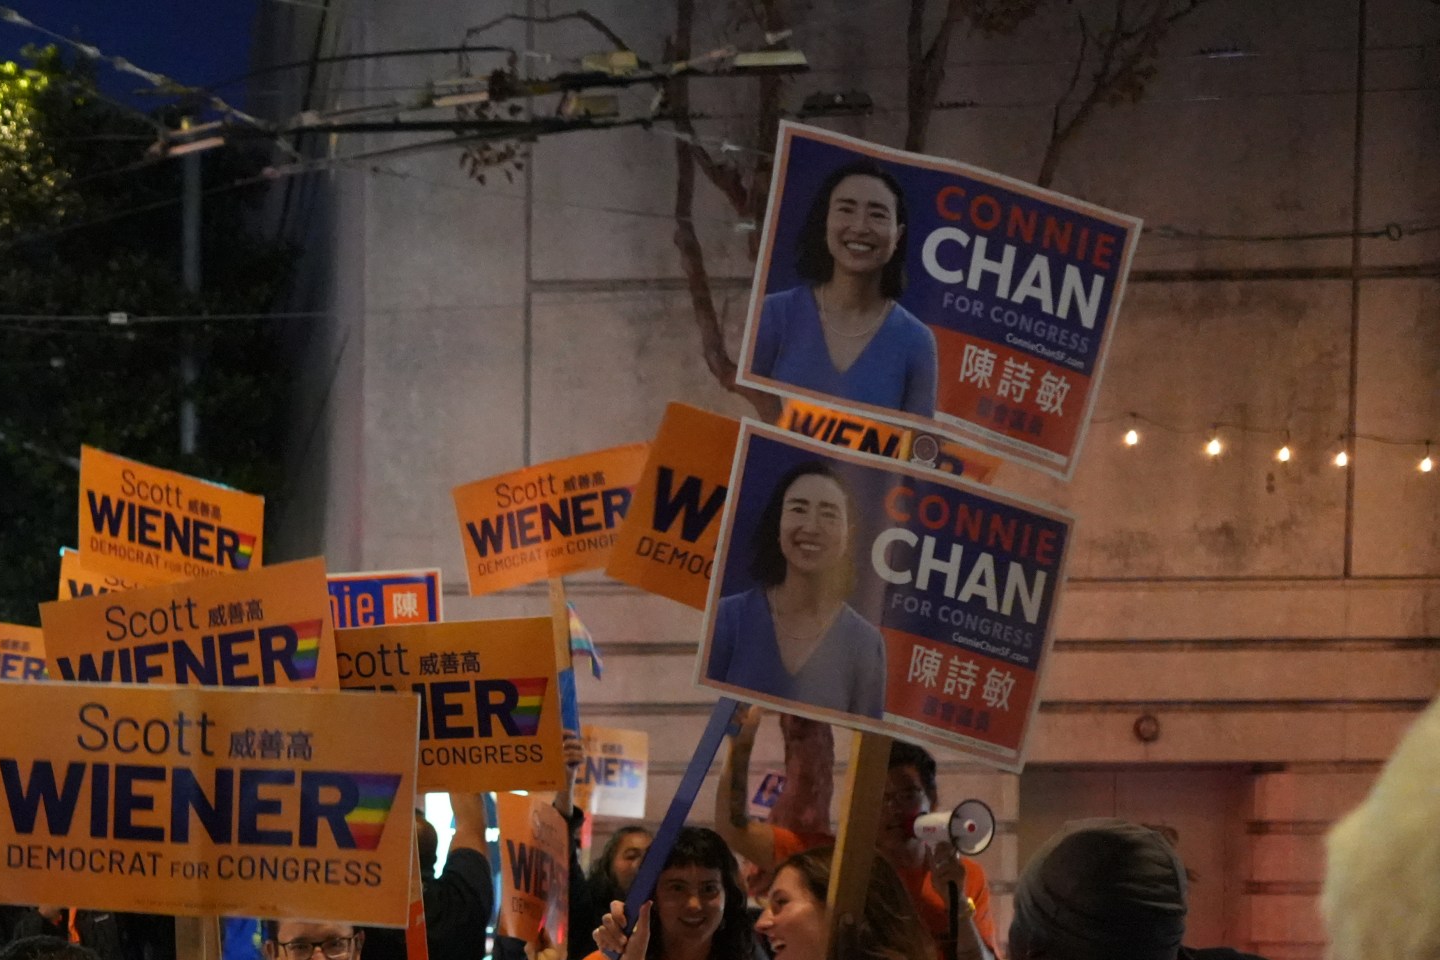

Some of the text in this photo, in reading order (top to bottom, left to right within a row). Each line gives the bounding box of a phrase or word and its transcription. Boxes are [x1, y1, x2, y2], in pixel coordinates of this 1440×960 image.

[936, 186, 1116, 270] CONNIE
[922, 226, 1105, 330] CHAN
[943, 292, 1091, 354] FOR CONGRESS
[959, 344, 1071, 416] 陳詩敏
[120, 468, 183, 510] Scott
[495, 472, 557, 509] Scott
[87, 489, 242, 570] WIENER
[466, 486, 633, 558] WIENER
[884, 486, 1057, 566] CONNIE
[90, 537, 160, 570] DEMOCRAT
[478, 548, 542, 576] DEMOCRAT
[635, 536, 713, 580] DEMOC
[871, 528, 1048, 625] CHAN
[105, 598, 200, 641] Scott
[208, 600, 264, 628] 威善高
[891, 593, 1034, 649] FOR CONGRESS
[57, 624, 300, 686] WIENER
[336, 642, 410, 680] cott
[419, 651, 481, 675] 威善高
[908, 644, 1016, 712] 陳詩敏
[76, 702, 216, 757] Scott
[228, 729, 314, 761] 威善高
[421, 744, 544, 766] CONGRESS
[7, 844, 382, 887] DEMOCRAT FOR CONGRESS
